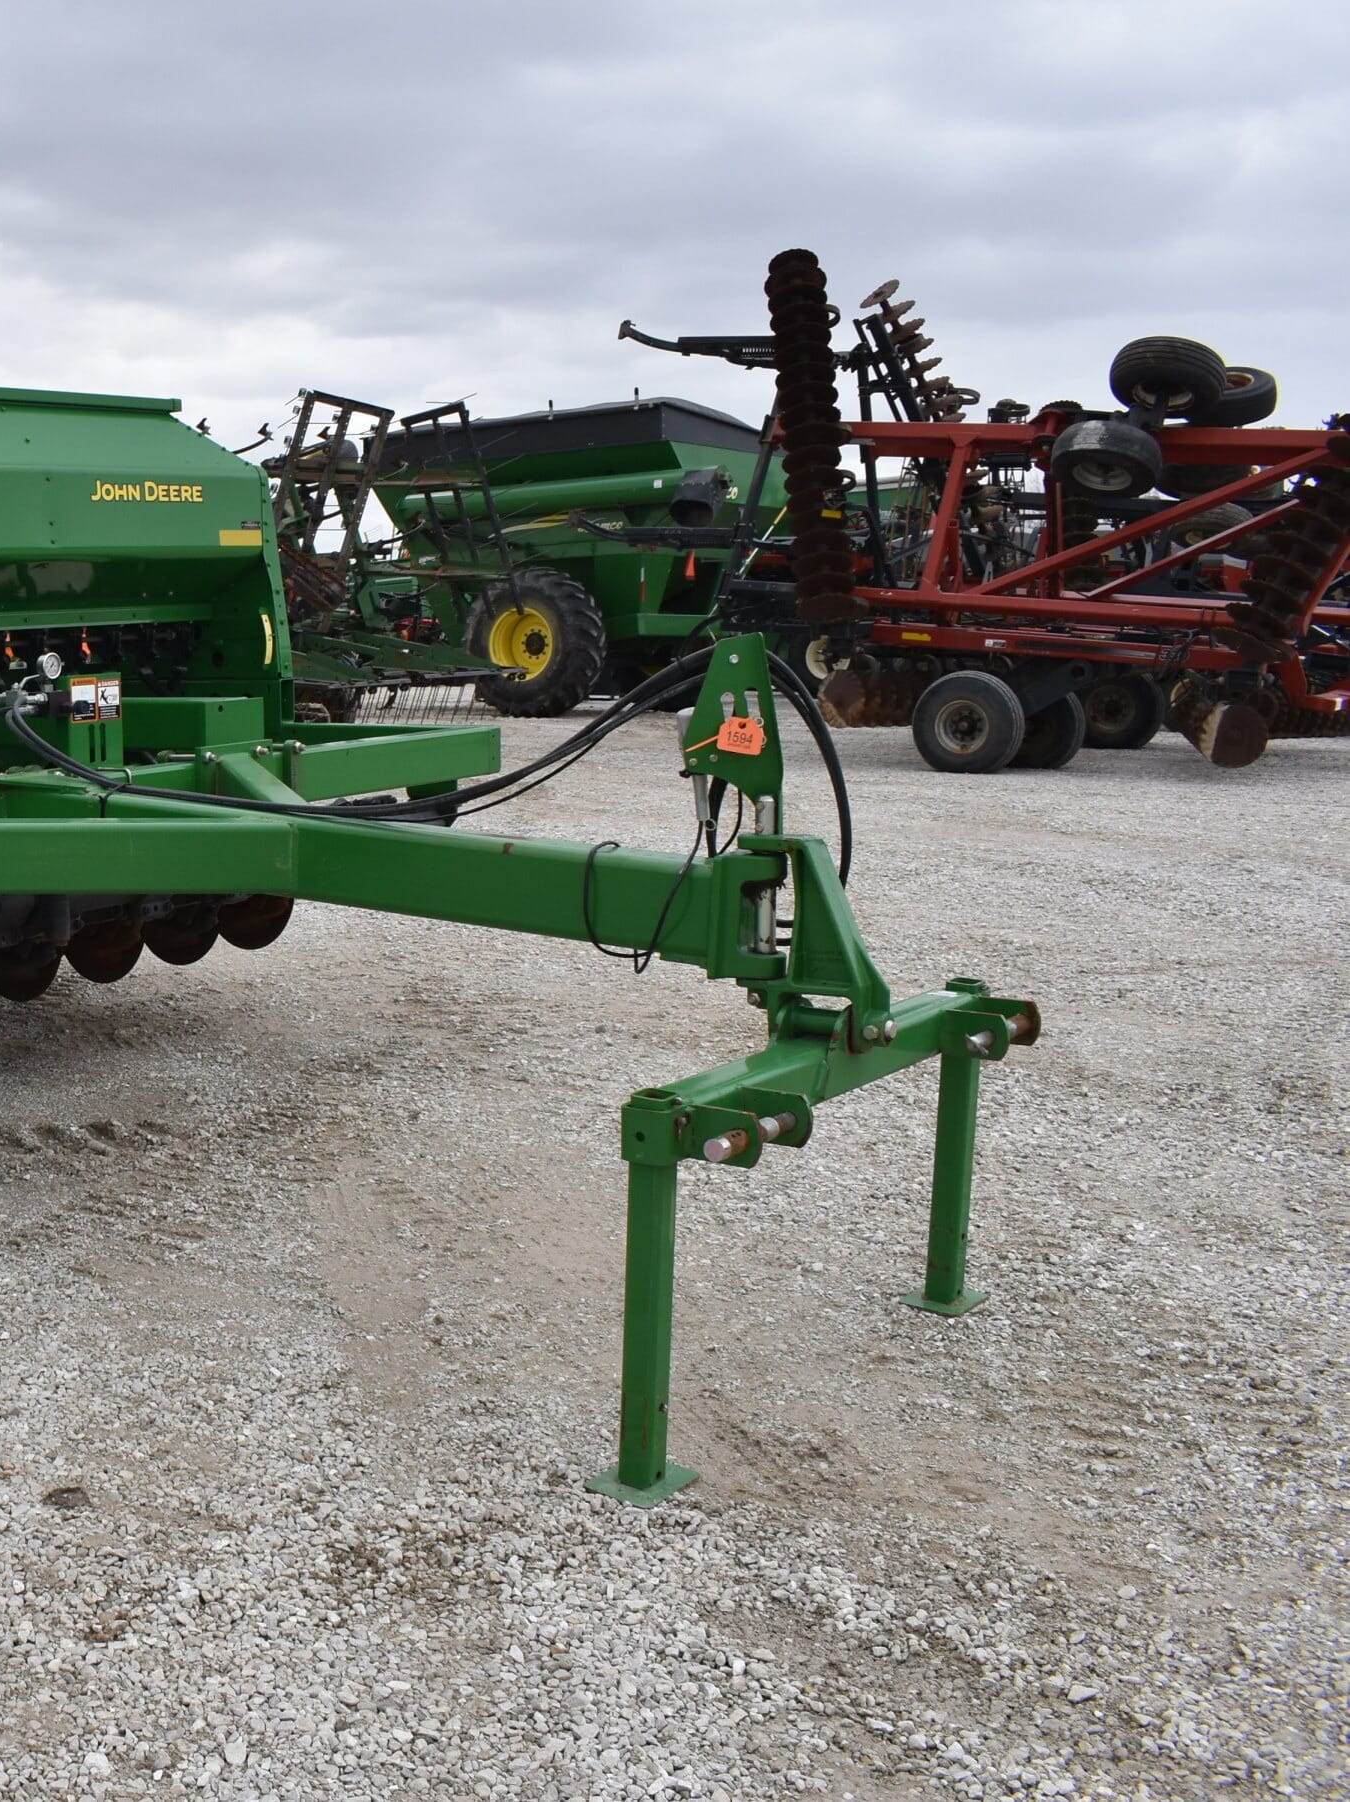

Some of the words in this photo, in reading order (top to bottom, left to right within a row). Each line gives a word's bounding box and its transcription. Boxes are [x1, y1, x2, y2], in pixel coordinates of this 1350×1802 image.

[91, 480, 140, 501] JOHN
[144, 481, 203, 502] DEERE
[727, 730, 753, 744] 1594
